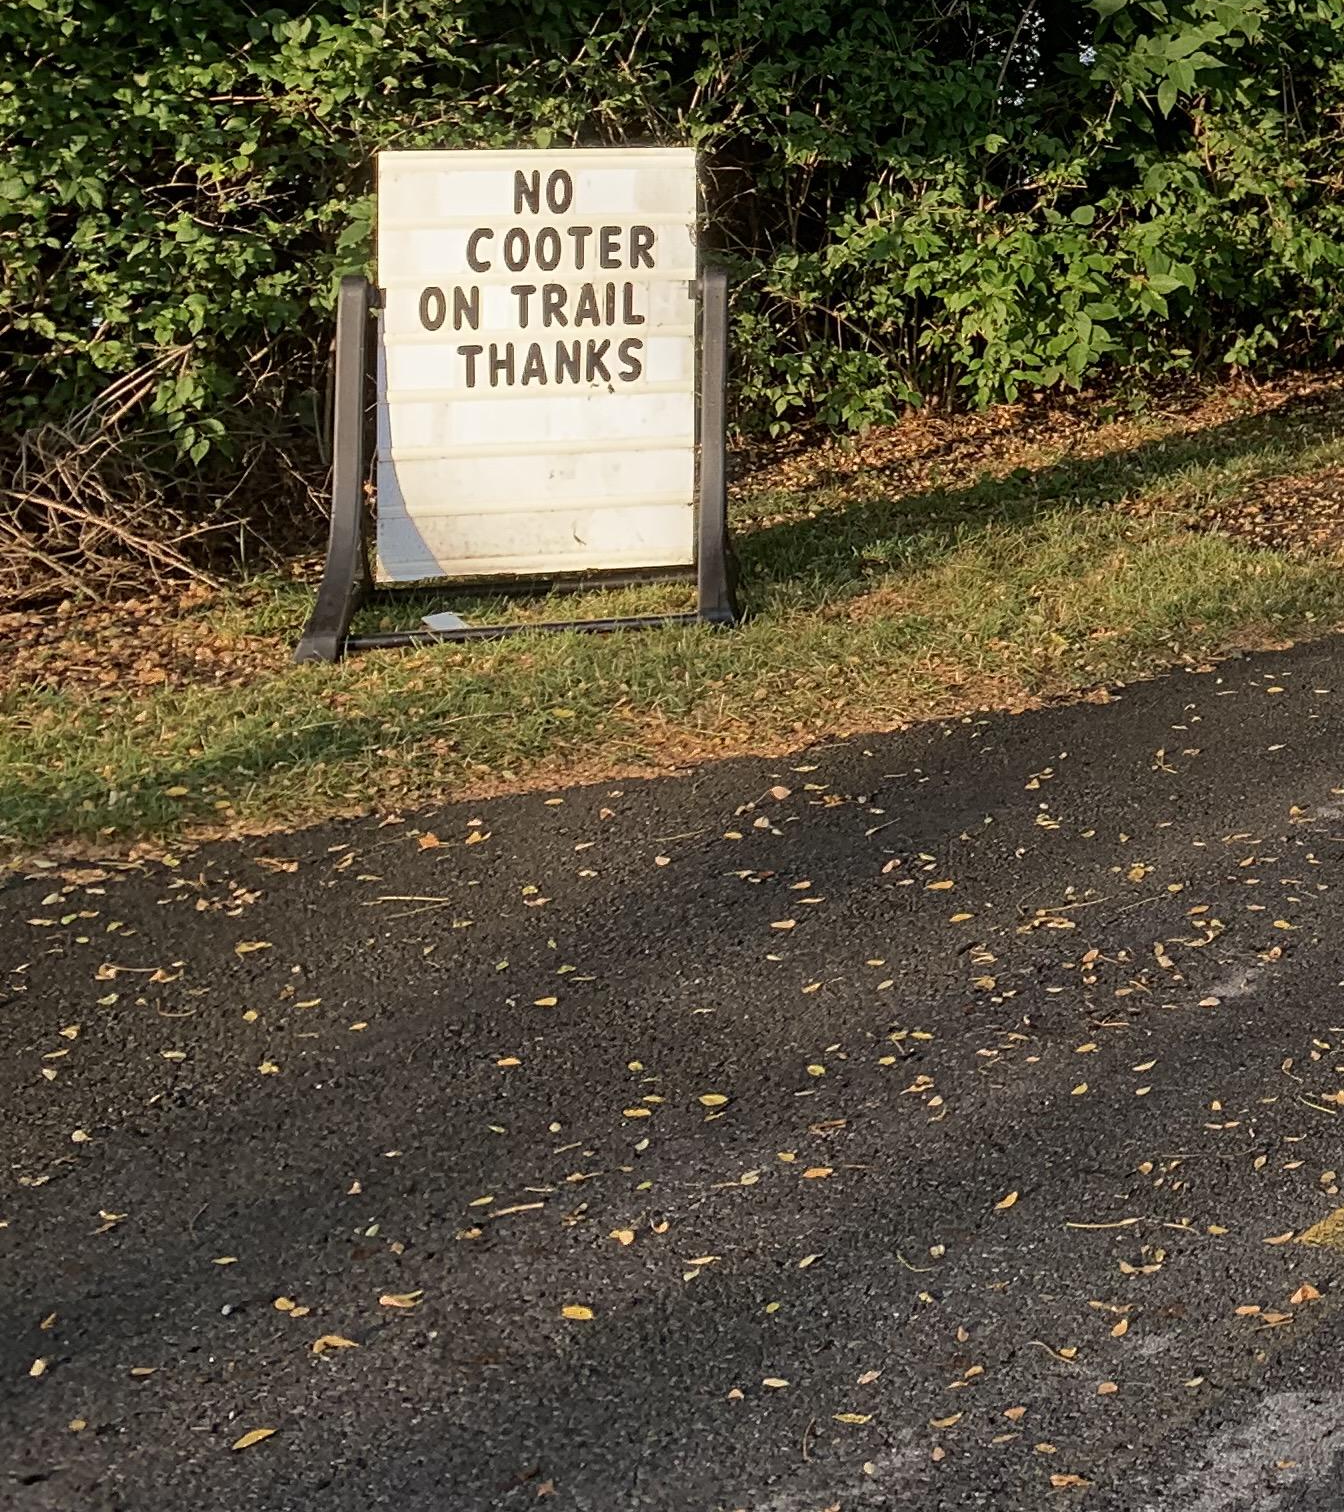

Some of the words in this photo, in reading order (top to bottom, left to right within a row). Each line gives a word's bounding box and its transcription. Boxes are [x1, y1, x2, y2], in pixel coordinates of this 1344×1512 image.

[514, 169, 574, 215] NO
[466, 225, 656, 273] COOTER
[419, 285, 480, 331] ON
[510, 281, 645, 328] TRAIL
[457, 338, 644, 388] THANKS
